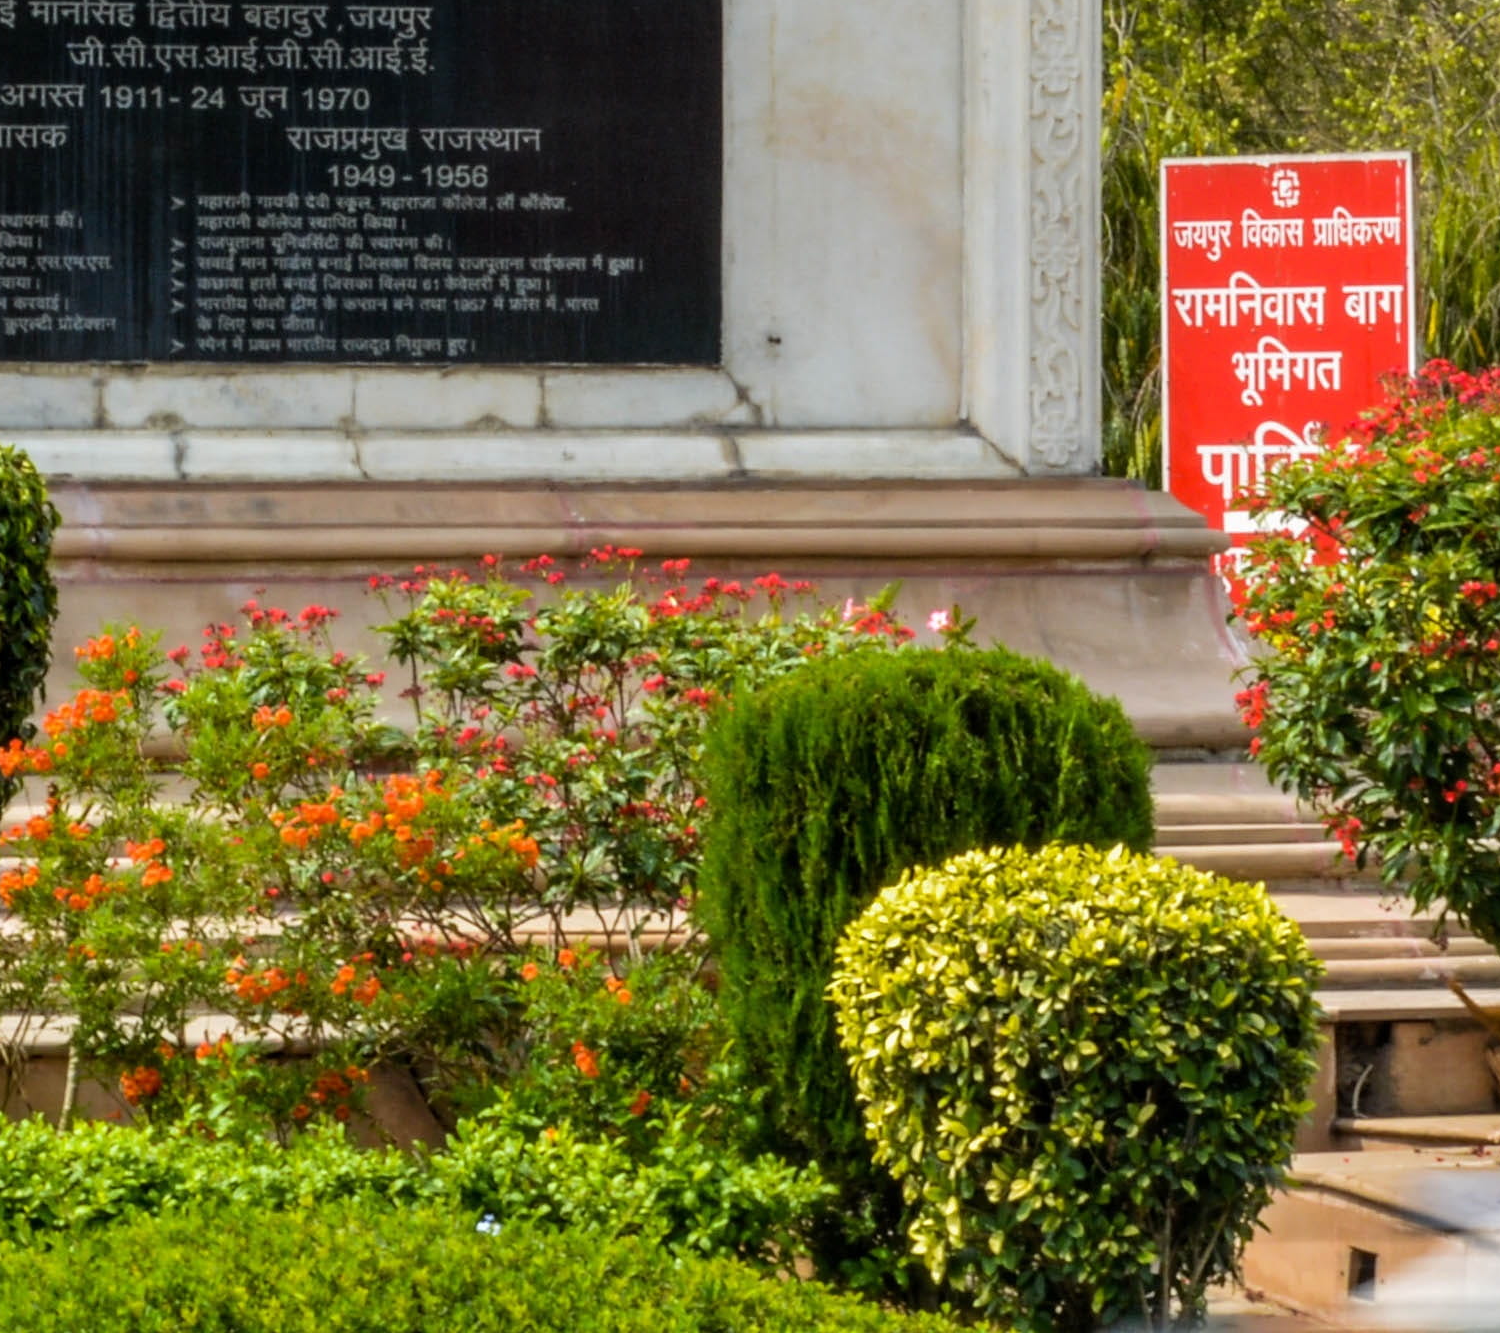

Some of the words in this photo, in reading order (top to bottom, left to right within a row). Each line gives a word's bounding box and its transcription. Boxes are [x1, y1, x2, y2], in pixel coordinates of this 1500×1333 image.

[0, 84, 85, 108] अगस्त
[191, 88, 226, 110] 24
[238, 86, 288, 119] जून
[302, 88, 371, 111] 1970
[285, 127, 409, 160] राजप्रमुख
[419, 128, 542, 151] राजस्थान
[326, 165, 396, 188] 1949
[421, 165, 489, 188] 1956
[1173, 219, 1232, 261] जयपुर
[1241, 209, 1304, 248] विकास
[1312, 206, 1400, 247] प्राधिकरण
[1171, 271, 1327, 327] रामनिवास
[1342, 284, 1403, 325] बाग
[1231, 335, 1342, 407] भूमिगत
